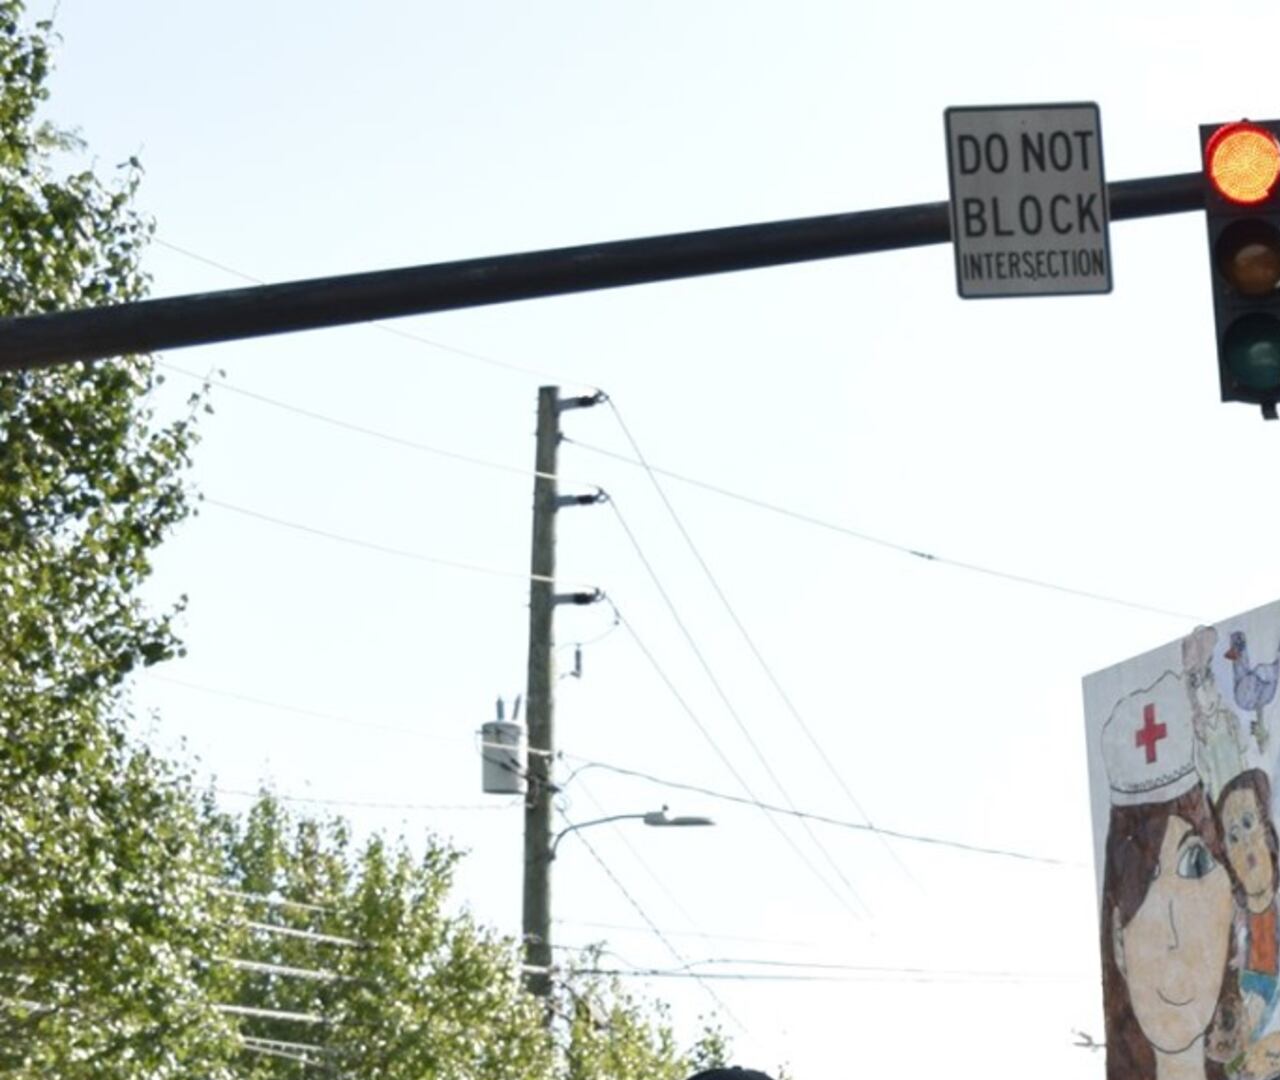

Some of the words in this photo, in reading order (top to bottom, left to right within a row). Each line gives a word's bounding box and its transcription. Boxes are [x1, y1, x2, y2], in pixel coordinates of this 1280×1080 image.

[957, 132, 1009, 175] DO
[1020, 130, 1094, 173] NOT
[962, 193, 1101, 238] BLOCK
[962, 248, 1105, 281] INTERSECTION
